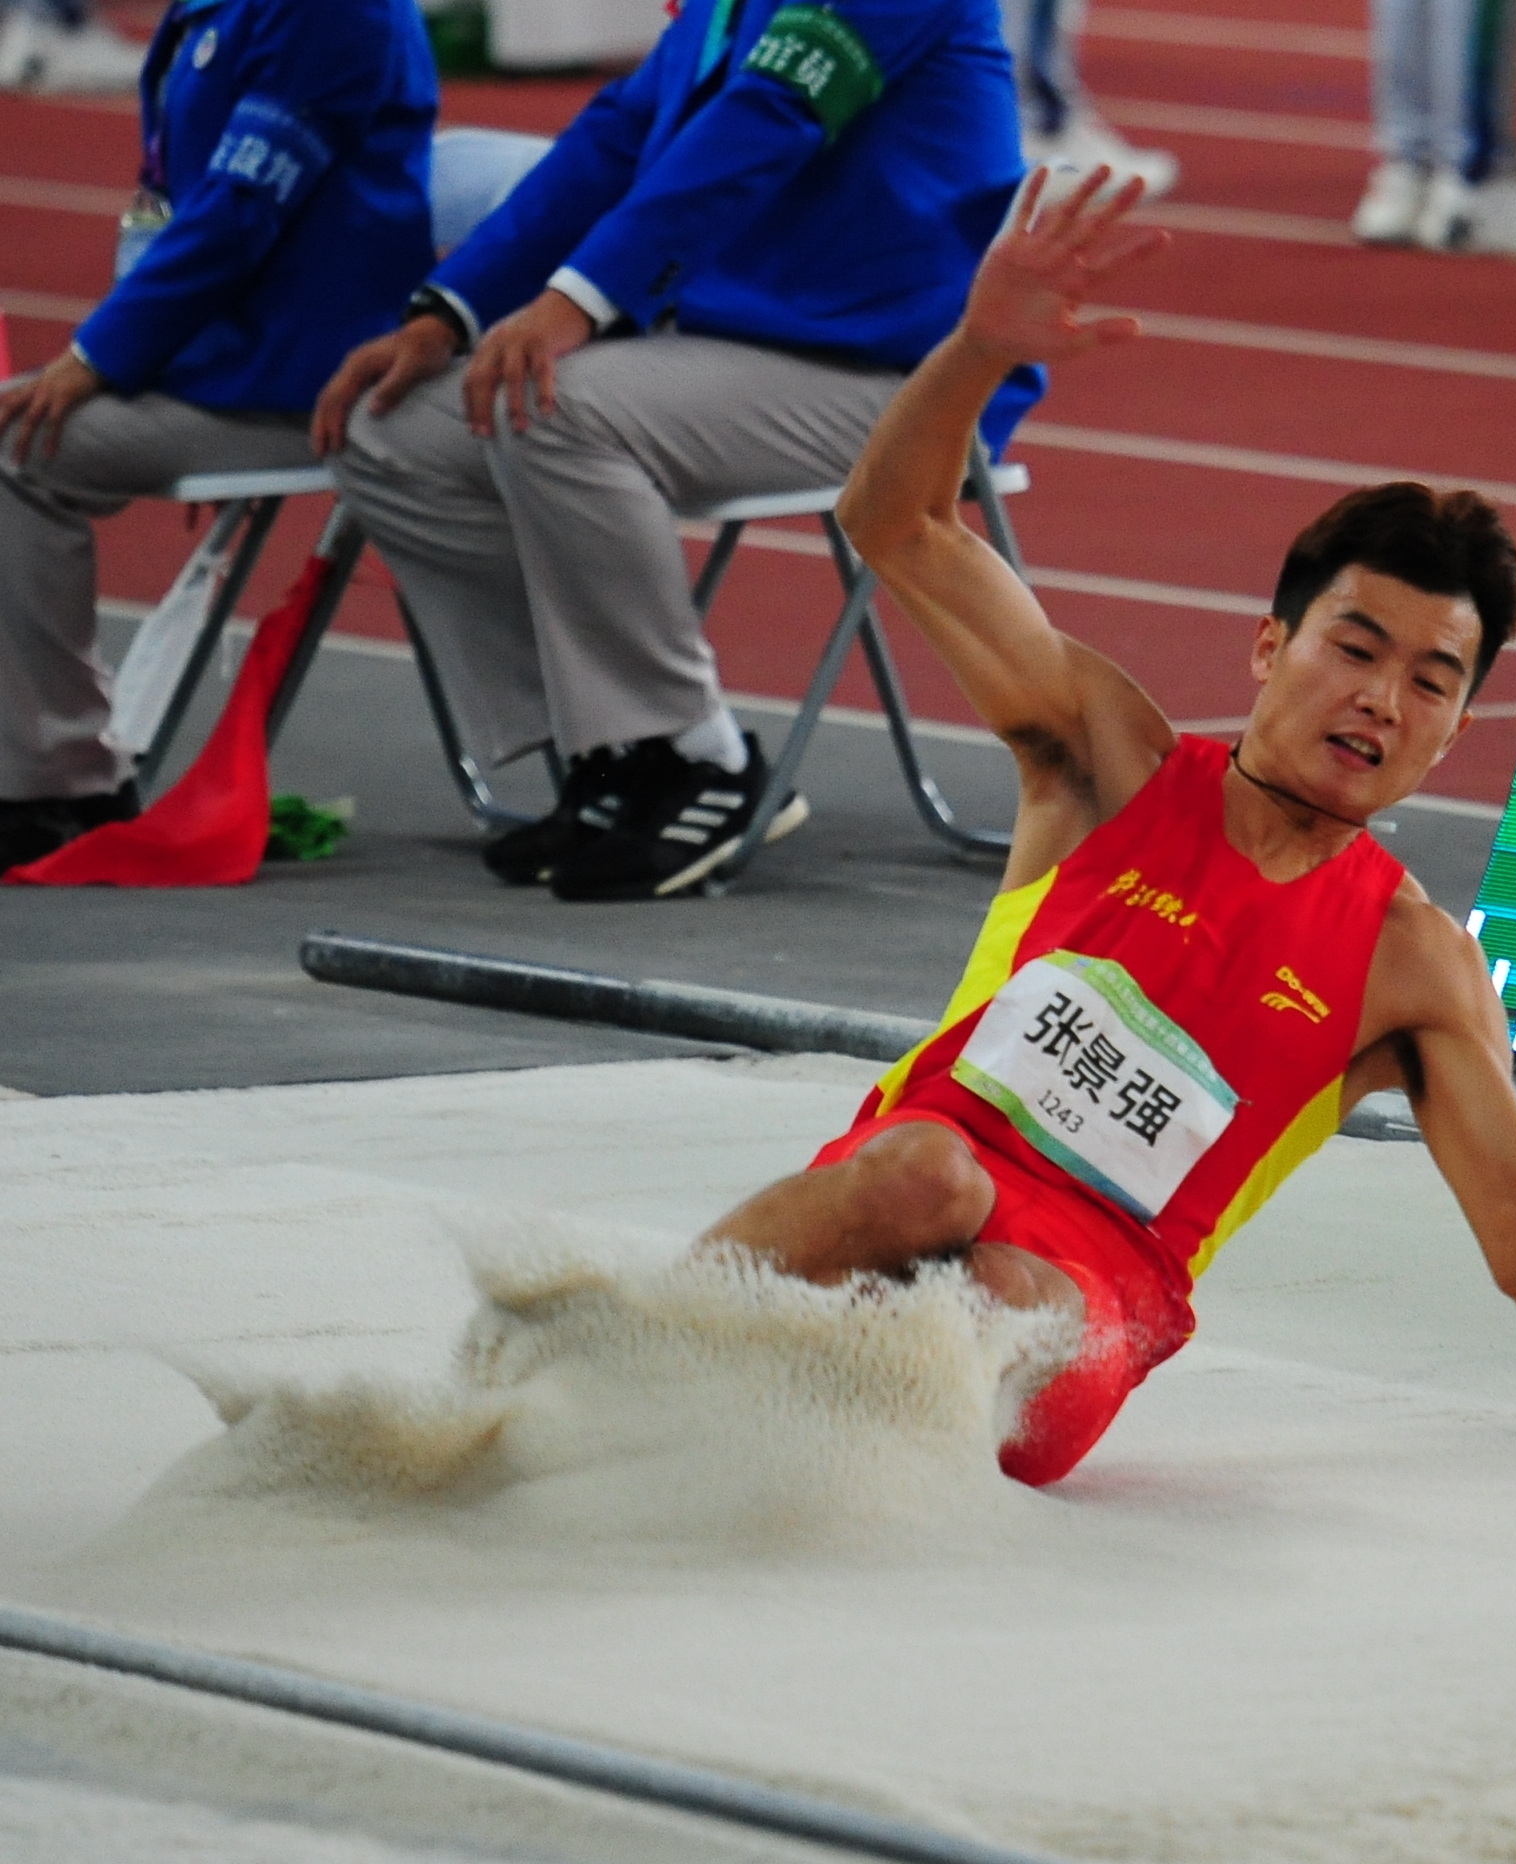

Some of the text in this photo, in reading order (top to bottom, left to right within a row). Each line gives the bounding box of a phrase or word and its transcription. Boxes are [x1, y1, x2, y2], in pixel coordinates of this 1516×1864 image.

[1023, 991, 1183, 1148] 张景强
[1037, 1089, 1085, 1134] 1243
